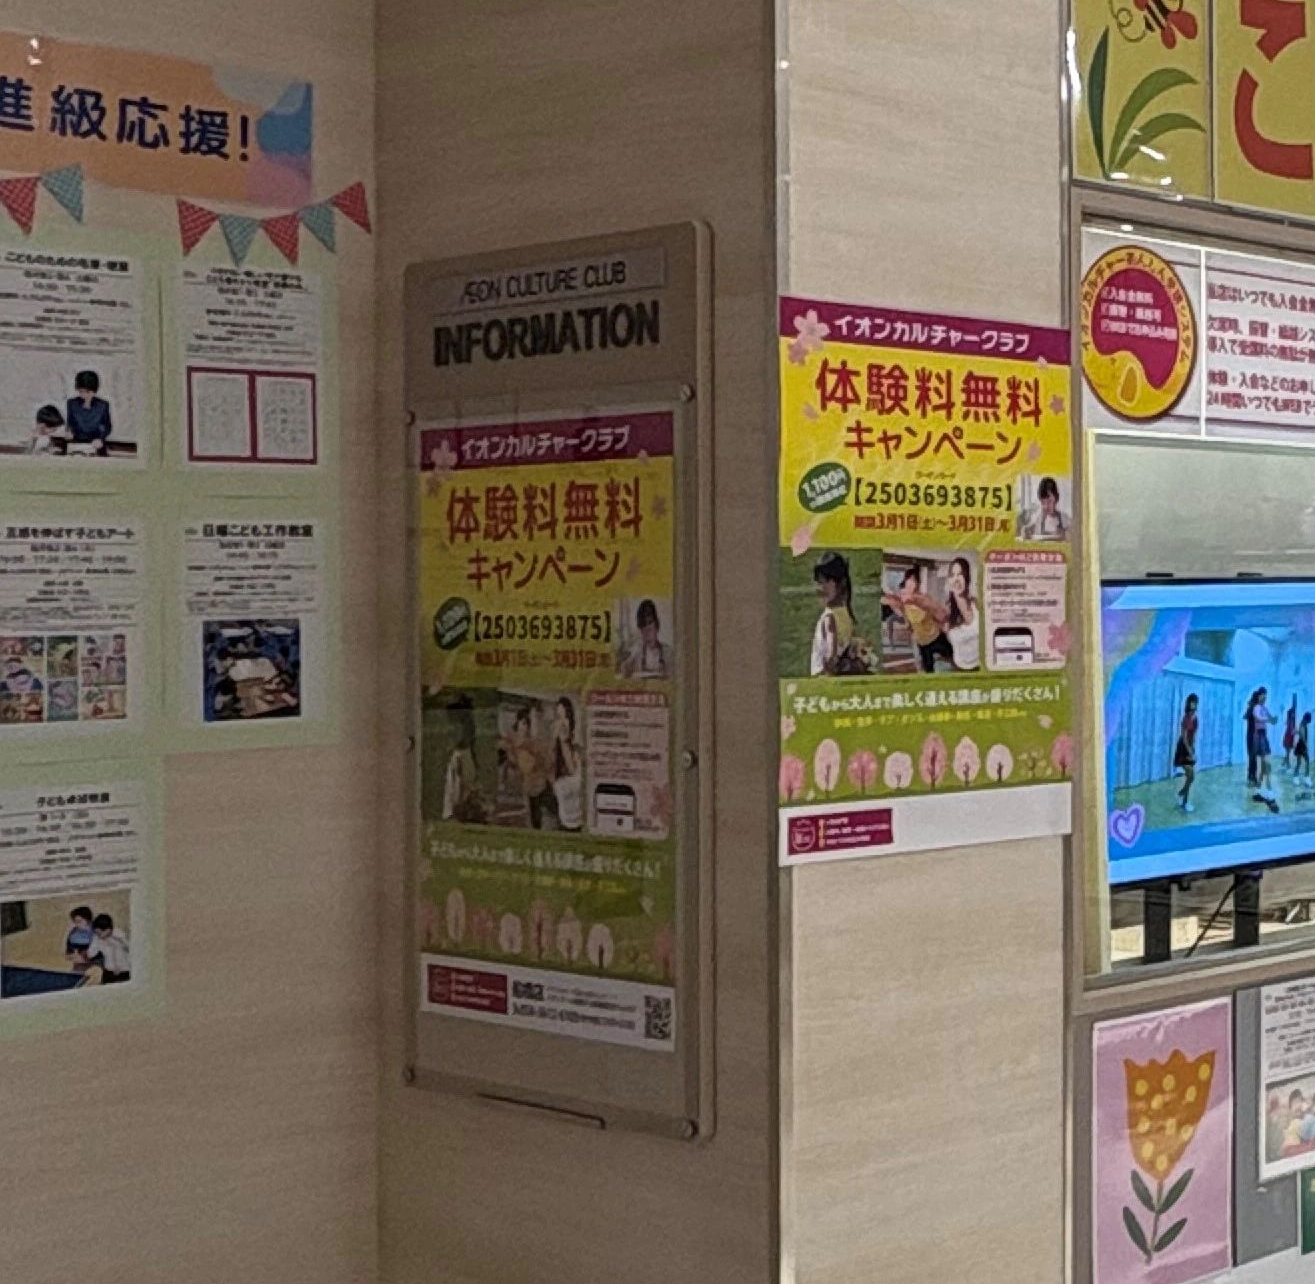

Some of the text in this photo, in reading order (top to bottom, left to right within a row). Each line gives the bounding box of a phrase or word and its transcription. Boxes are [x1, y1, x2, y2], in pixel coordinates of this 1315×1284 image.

[506, 266, 577, 298] CULTURE
[585, 260, 627, 286] CLUB
[433, 299, 661, 368] INFORMATION
[833, 314, 1032, 354] イオンカルチャークラブ
[815, 357, 1043, 428] 体験料無料
[461, 423, 631, 462] イオンカルチャークラブ
[844, 419, 1023, 465] キャンペーン
[446, 475, 644, 544] 体験料無料
[855, 477, 1012, 512] 【2503693875】
[466, 544, 621, 593] キャンペーン
